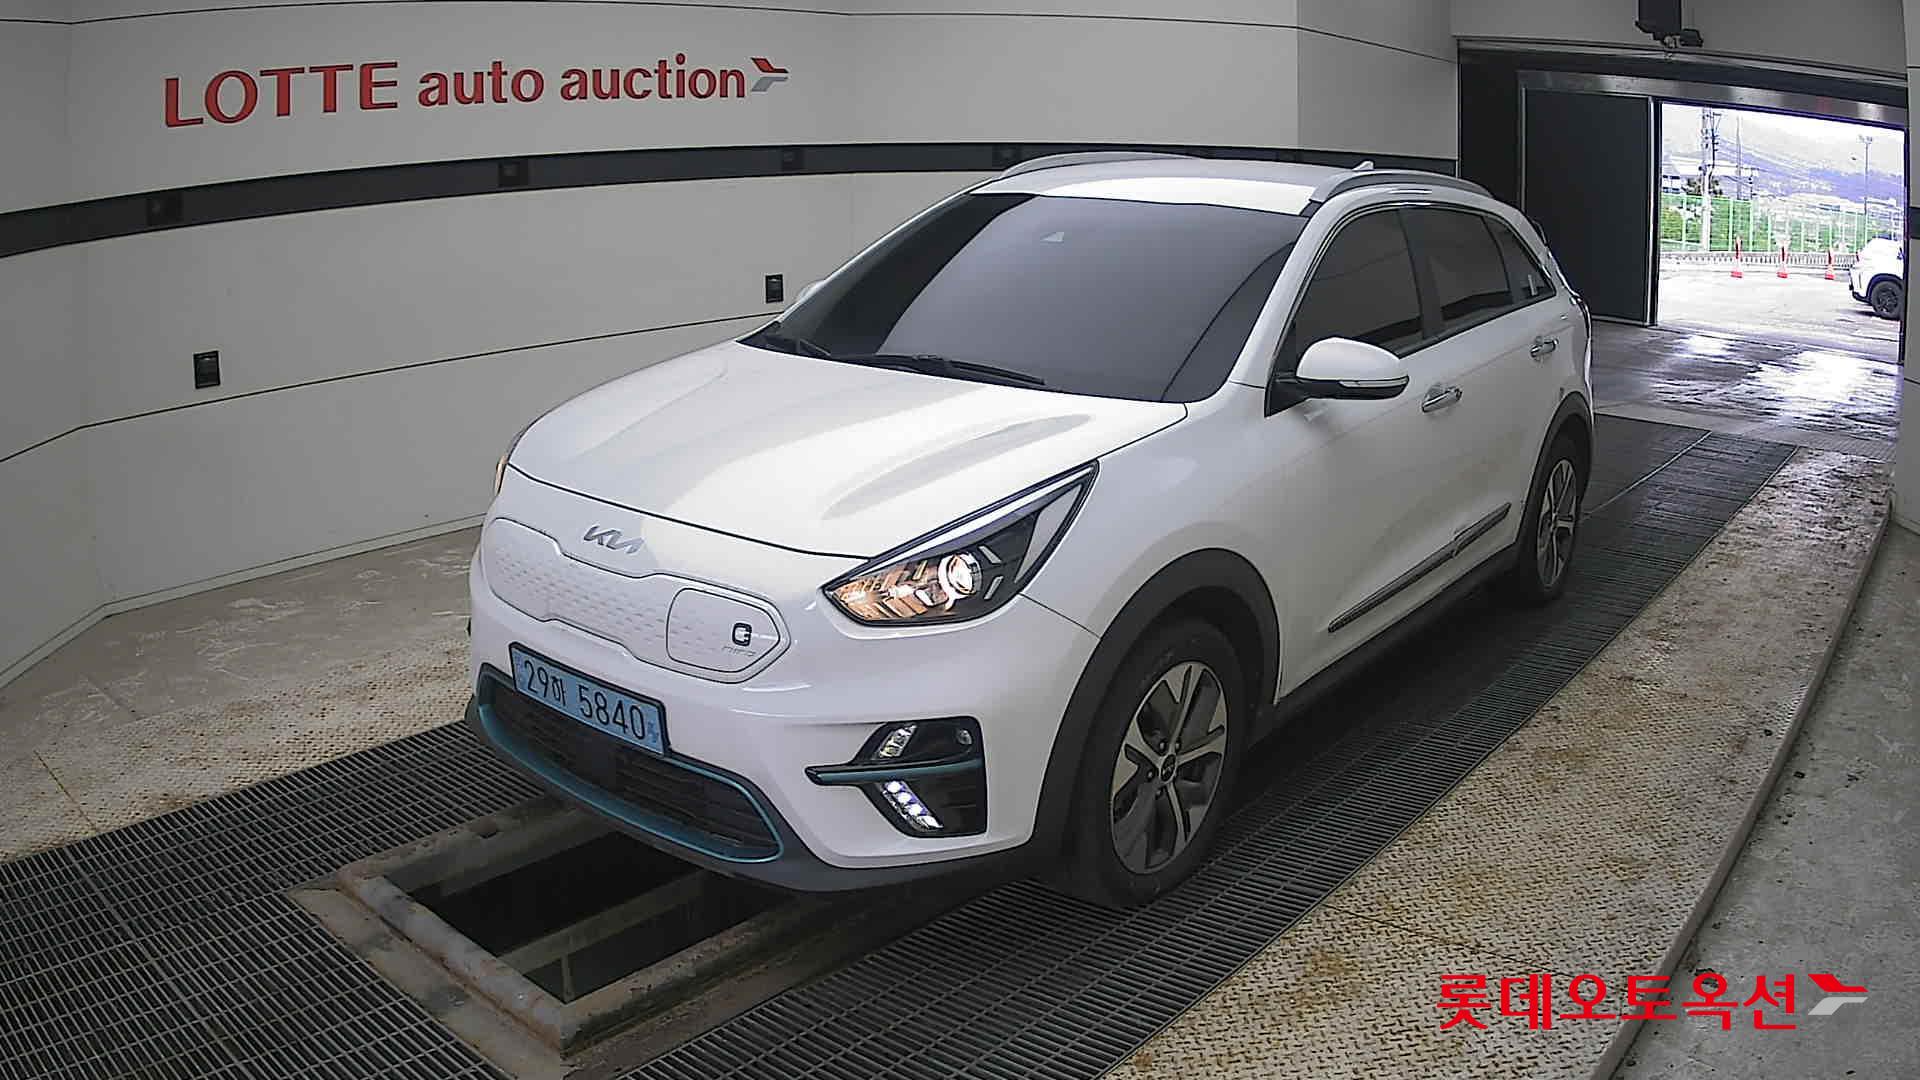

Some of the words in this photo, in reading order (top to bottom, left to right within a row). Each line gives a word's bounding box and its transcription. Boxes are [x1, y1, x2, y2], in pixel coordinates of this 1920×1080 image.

[164, 60, 398, 128] LOTTE
[417, 60, 545, 107] auto
[559, 52, 746, 101] auction
[583, 525, 645, 554] KIA
[577, 683, 646, 741] 5840
